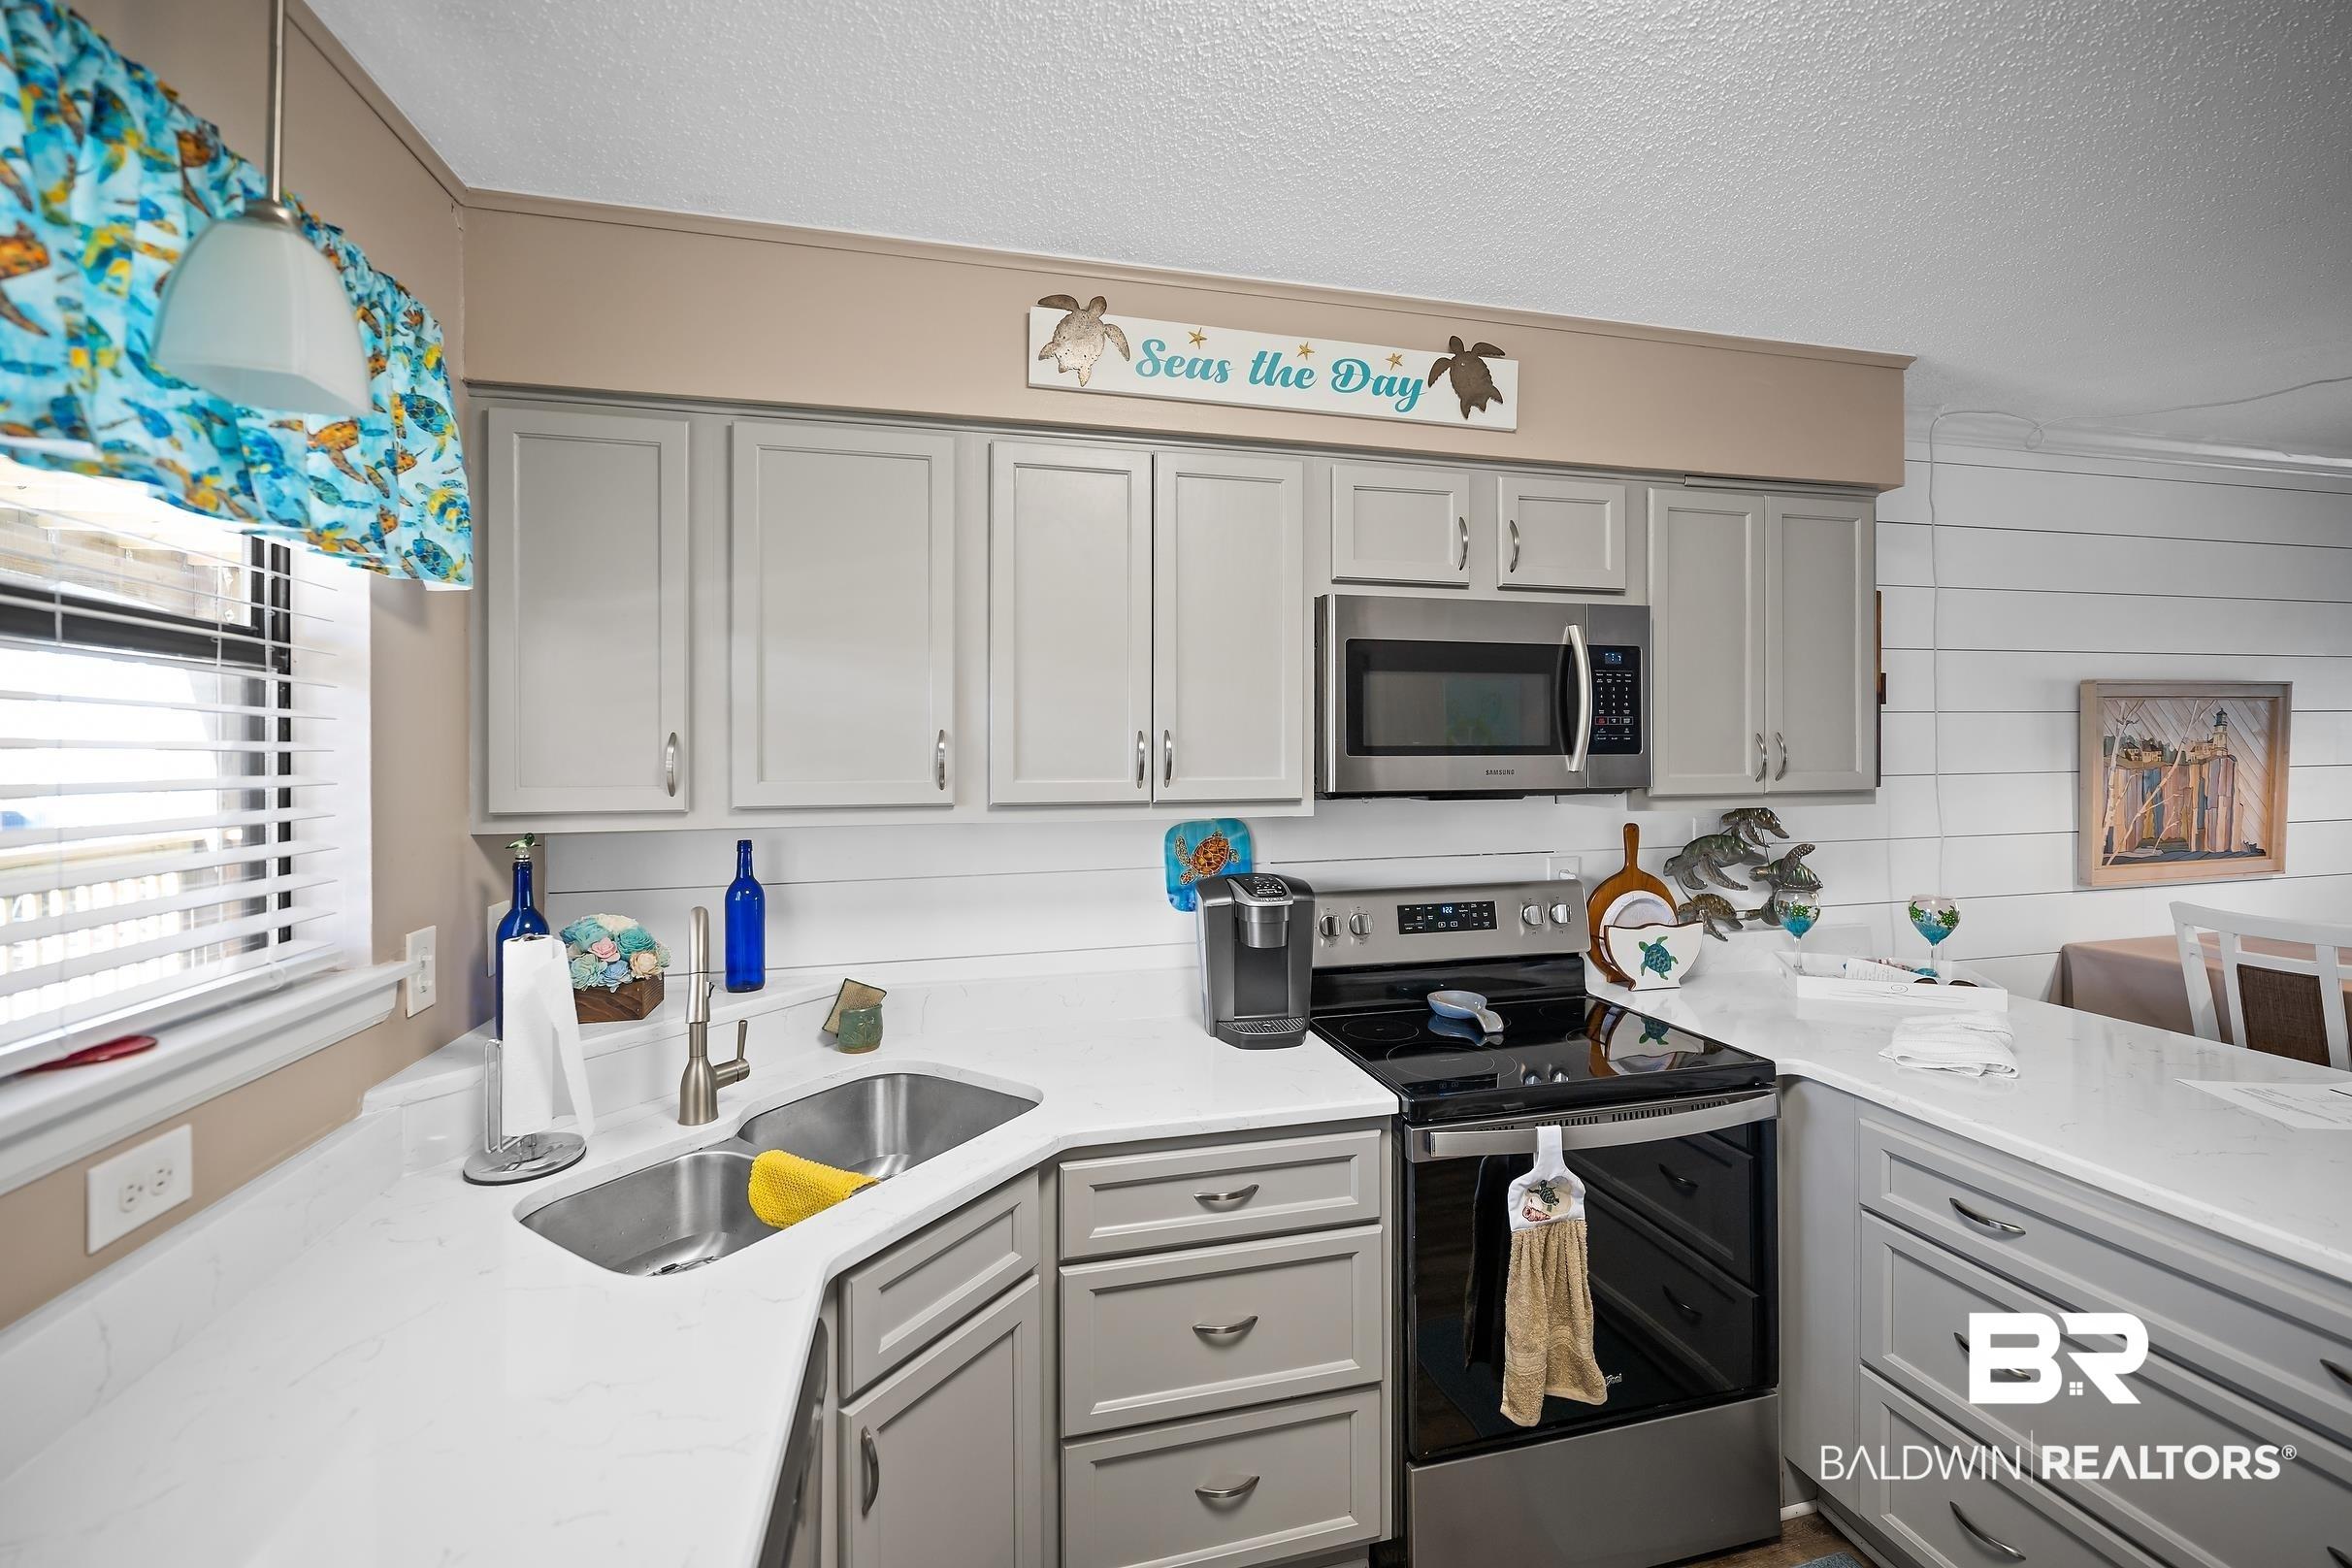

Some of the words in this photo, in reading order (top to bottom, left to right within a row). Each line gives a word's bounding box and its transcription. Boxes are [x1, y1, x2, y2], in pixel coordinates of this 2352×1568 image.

[1135, 339, 1232, 382] Seas
[1248, 350, 1317, 390] the
[1330, 358, 1427, 413] Day
